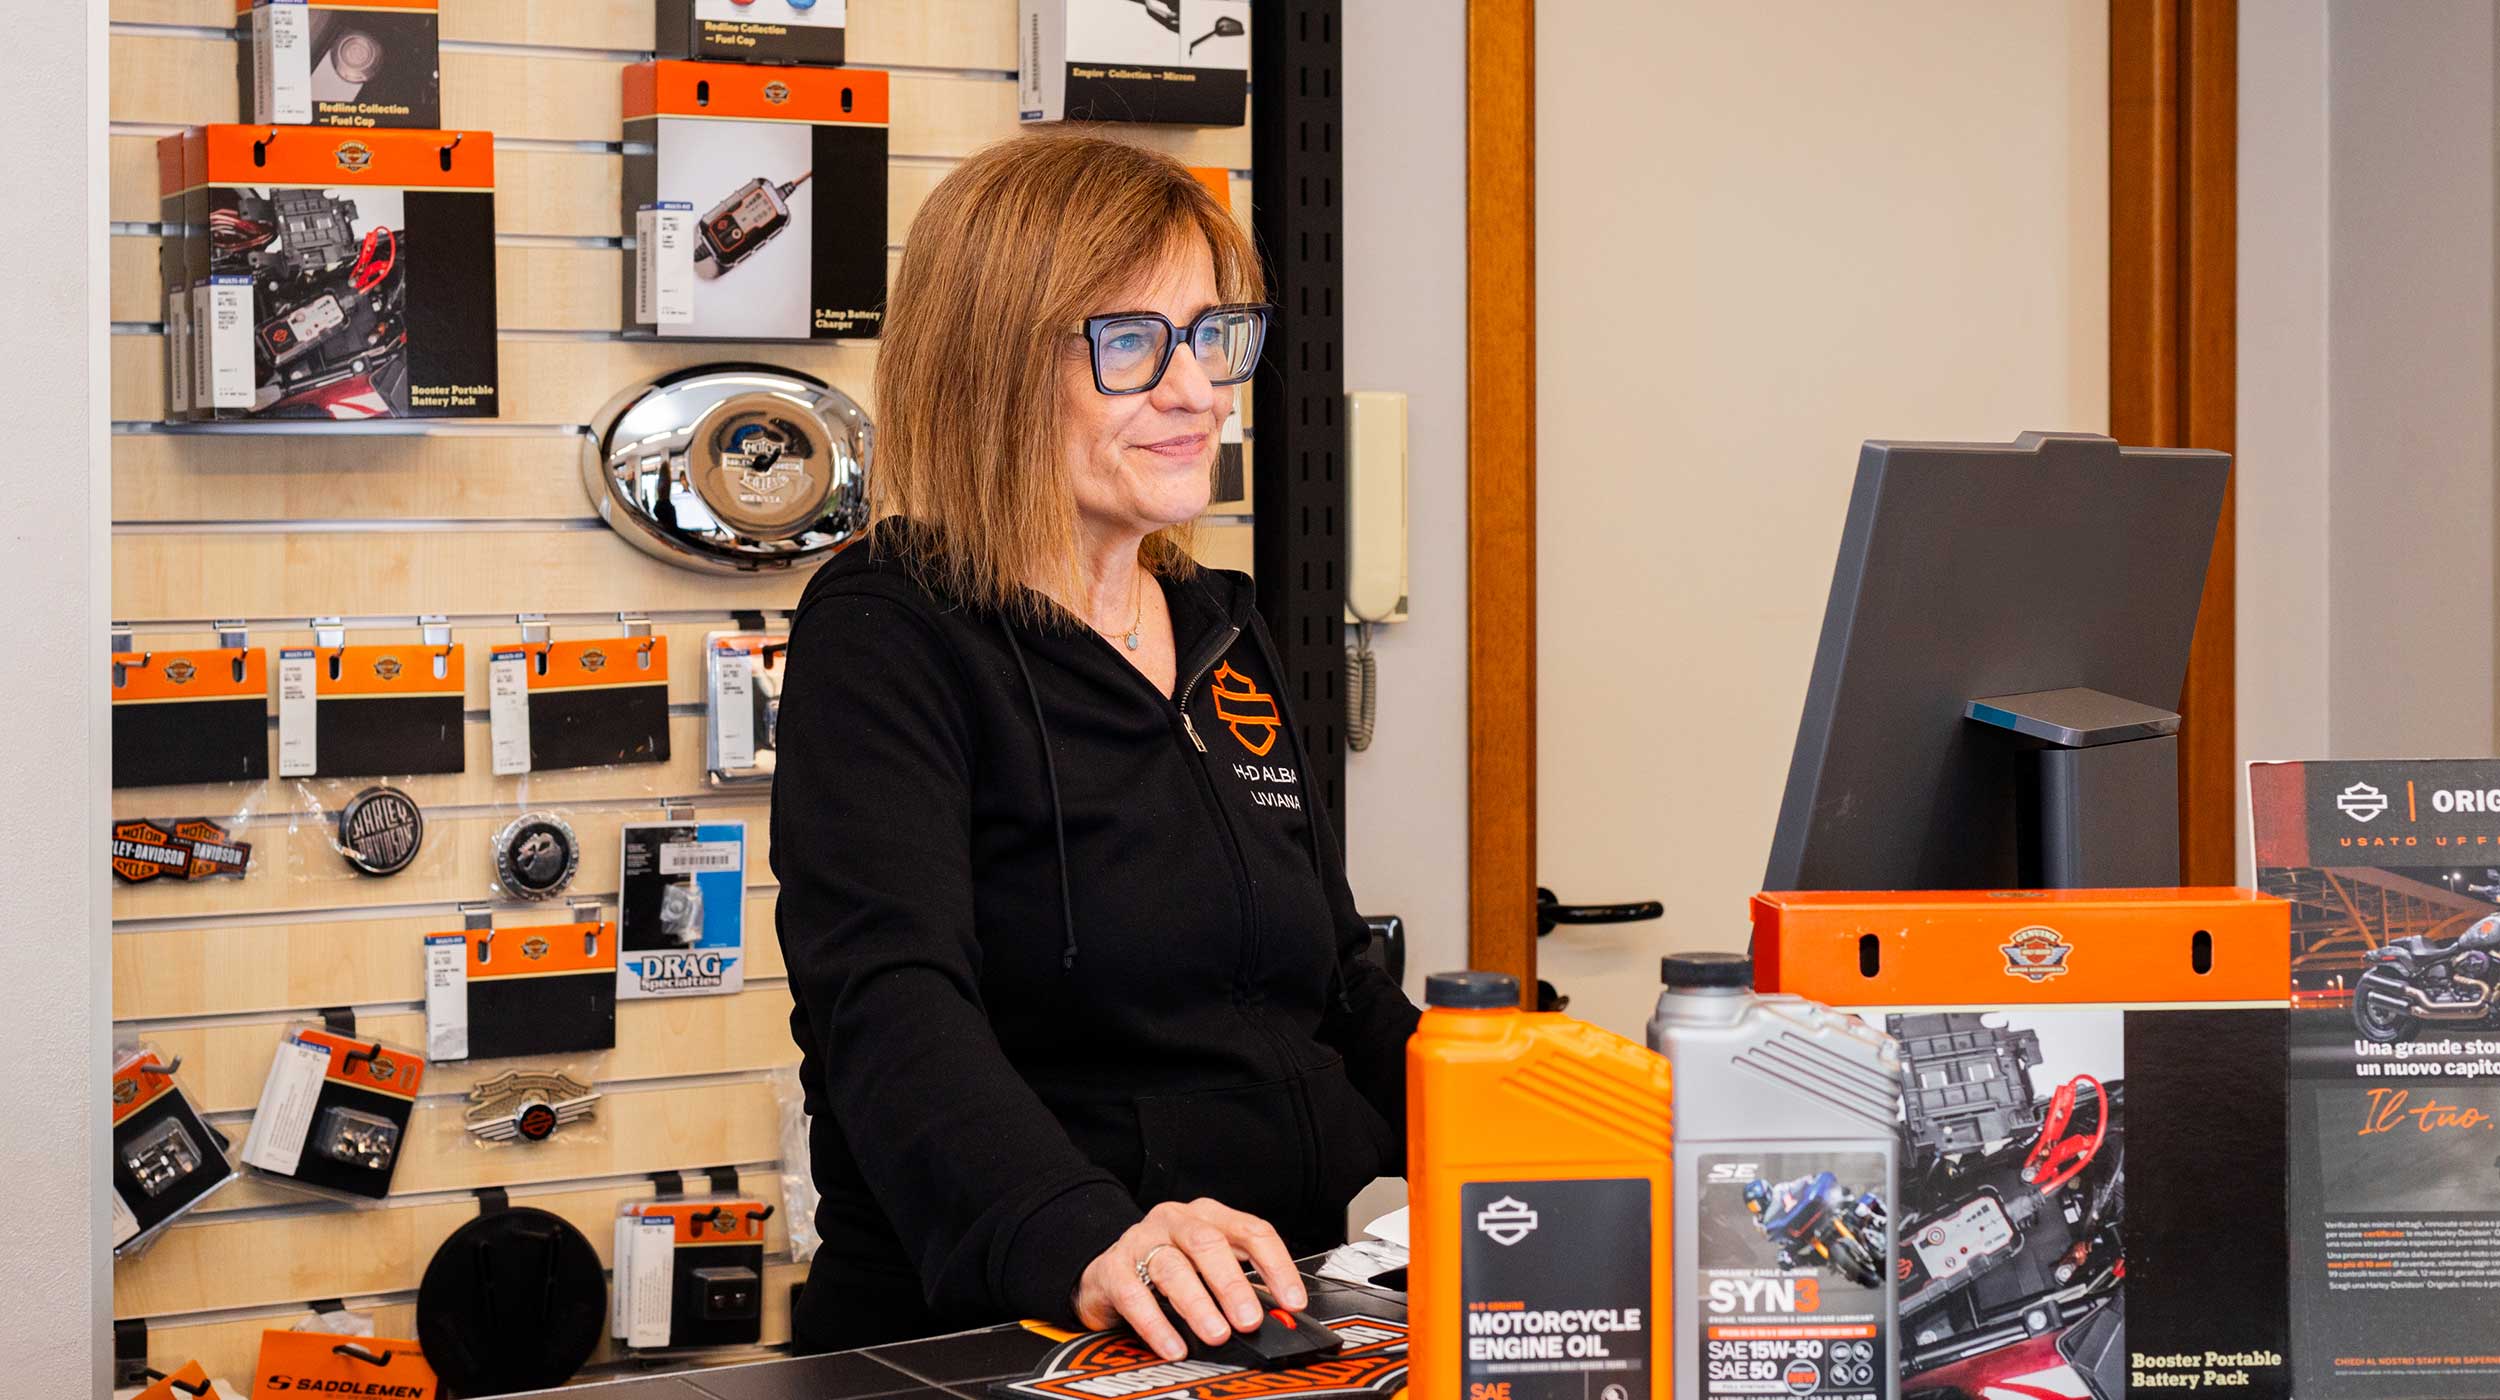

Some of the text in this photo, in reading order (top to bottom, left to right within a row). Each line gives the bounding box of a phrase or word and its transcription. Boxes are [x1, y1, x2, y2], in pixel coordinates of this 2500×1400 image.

[704, 21, 787, 35] Redline Collection
[715, 34, 736, 44] Fuel
[736, 35, 757, 47] Cap
[1108, 69, 1152, 80] Collection
[319, 103, 357, 114] Redline
[358, 103, 410, 115] Collection
[330, 115, 353, 126] Fuel
[354, 116, 376, 128] Cap
[815, 309, 882, 321] 5-Amp Battery
[815, 319, 853, 331] Charger
[411, 385, 494, 395] Booster Portable
[411, 396, 476, 408] Battery Pack
[1232, 763, 1298, 784] H-D ALBA
[1250, 790, 1302, 811] LIVIANA
[2432, 789, 2500, 813] ORIG
[122, 828, 162, 843] MOTOR
[181, 827, 219, 840] MOTOR
[2340, 836, 2500, 848] USATO UFF
[112, 840, 186, 867] LEY-DAVIDSON
[192, 843, 243, 866] DAVIDSON
[641, 953, 721, 980] DRAG
[2355, 1039, 2500, 1059] Una grande stor
[2356, 1059, 2500, 1079] un nuovo capito
[2357, 1087, 2494, 1136] Il tuo.
[1707, 1163, 1759, 1178] SE
[2343, 1252, 2378, 1260] promessa
[2470, 1250, 2490, 1258] moto
[2455, 1270, 2485, 1278] garanzia
[1708, 1278, 1820, 1313] SYN3
[1469, 1308, 1642, 1335] MOTORCYCLE
[1469, 1335, 1610, 1360] ENGINE OIL
[1708, 1340, 1824, 1360] SAE 15W-50
[2131, 1350, 2282, 1368] Booster Portable
[2335, 1356, 2500, 1366] CHIEDI AL NOSTRO STAFF PER SAPERN
[1708, 1361, 1778, 1380] SAE 50
[296, 1378, 424, 1398] SADDLEMEN
[2131, 1370, 2249, 1390] Battery Pack
[1470, 1382, 1512, 1399] SAE
